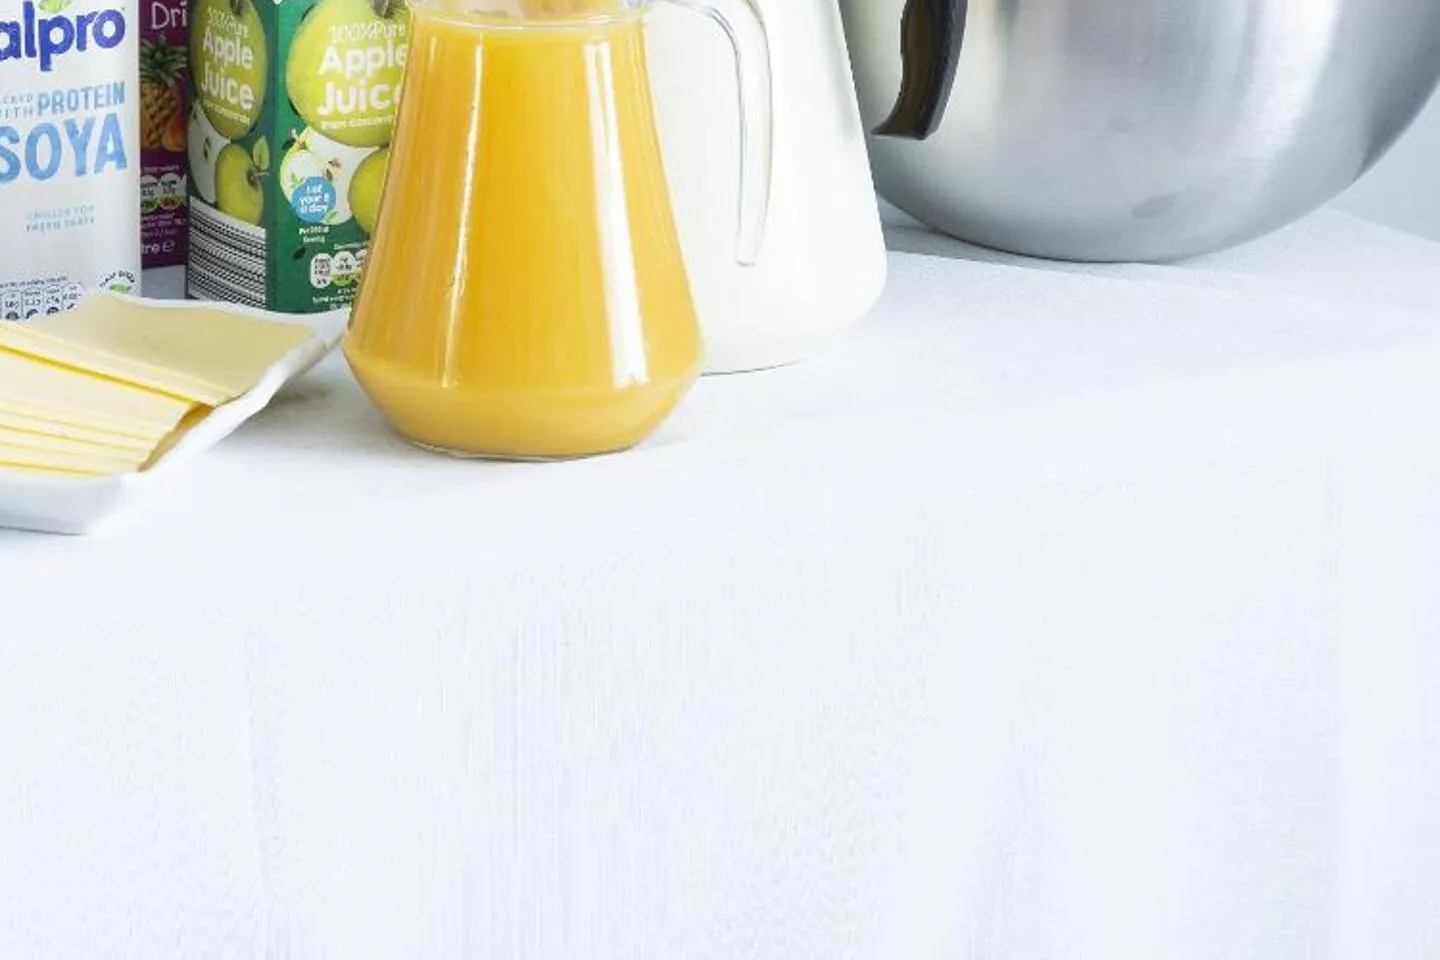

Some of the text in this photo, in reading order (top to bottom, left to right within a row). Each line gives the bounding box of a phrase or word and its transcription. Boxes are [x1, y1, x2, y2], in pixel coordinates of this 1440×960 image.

[151, 2, 188, 30] Dri
[203, 26, 253, 70] Apple
[317, 39, 409, 81] Apple
[37, 81, 125, 116] PROTEIN
[201, 61, 254, 110] Juice
